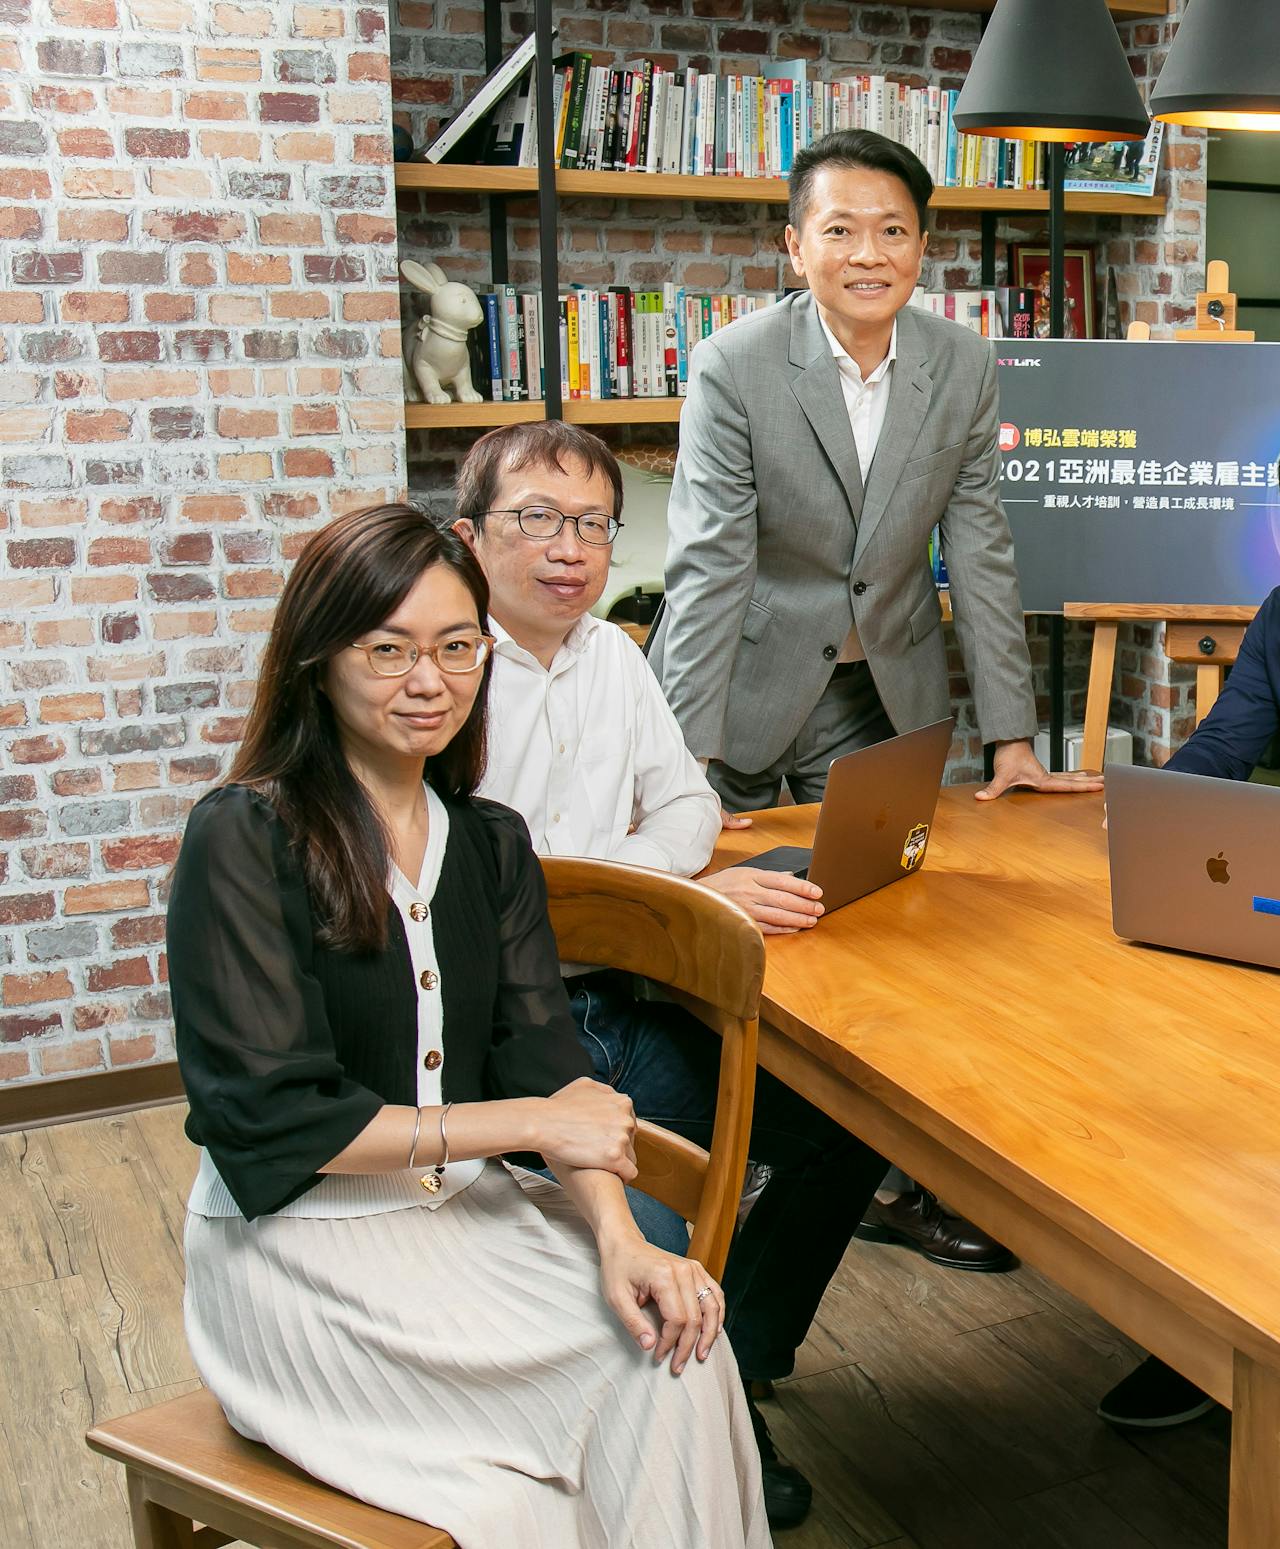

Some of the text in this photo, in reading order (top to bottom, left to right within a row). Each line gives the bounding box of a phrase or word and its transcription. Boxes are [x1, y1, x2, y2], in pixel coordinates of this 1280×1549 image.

[1024, 428, 1137, 449] 博弘雲端榮獲
